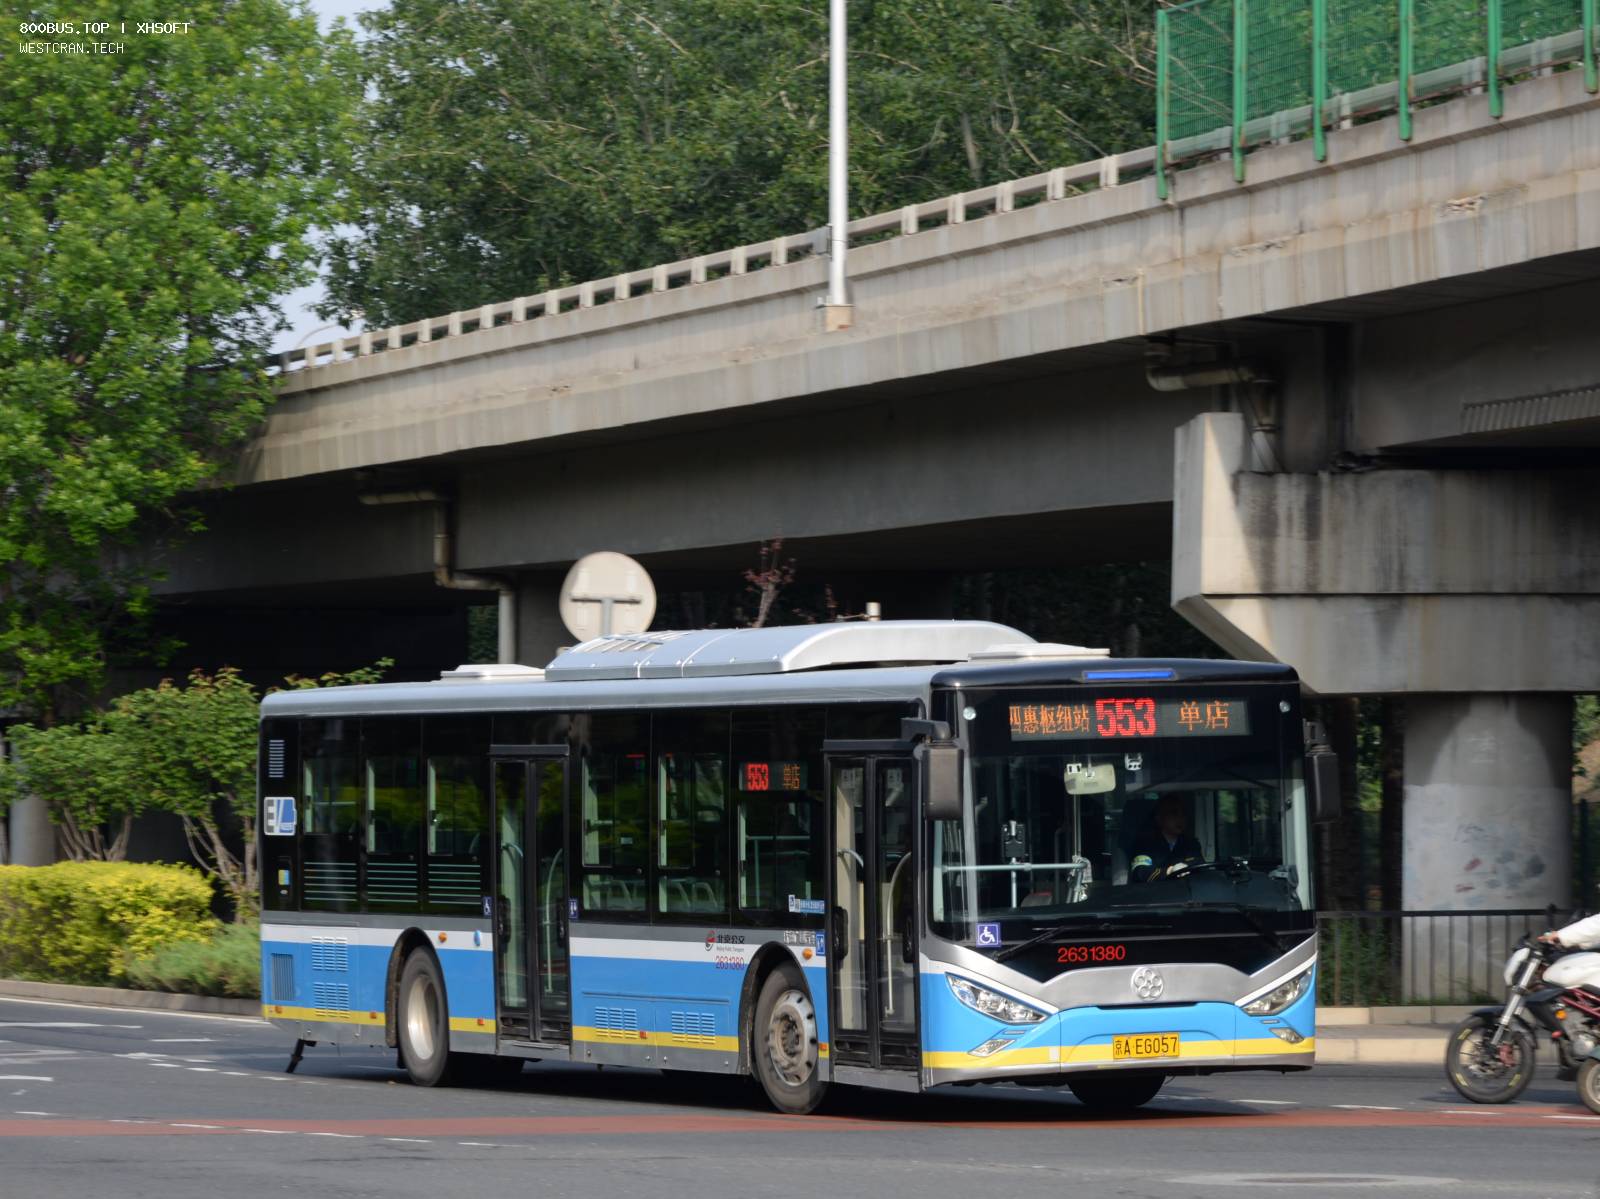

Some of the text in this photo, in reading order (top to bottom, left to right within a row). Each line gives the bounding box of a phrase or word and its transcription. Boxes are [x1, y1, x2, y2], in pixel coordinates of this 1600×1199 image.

[1009, 698, 1231, 736] 四惠枢纽站 553 单店
[746, 763, 769, 790] 553
[716, 955, 746, 970] 2631380
[1057, 945, 1127, 962] 2631380
